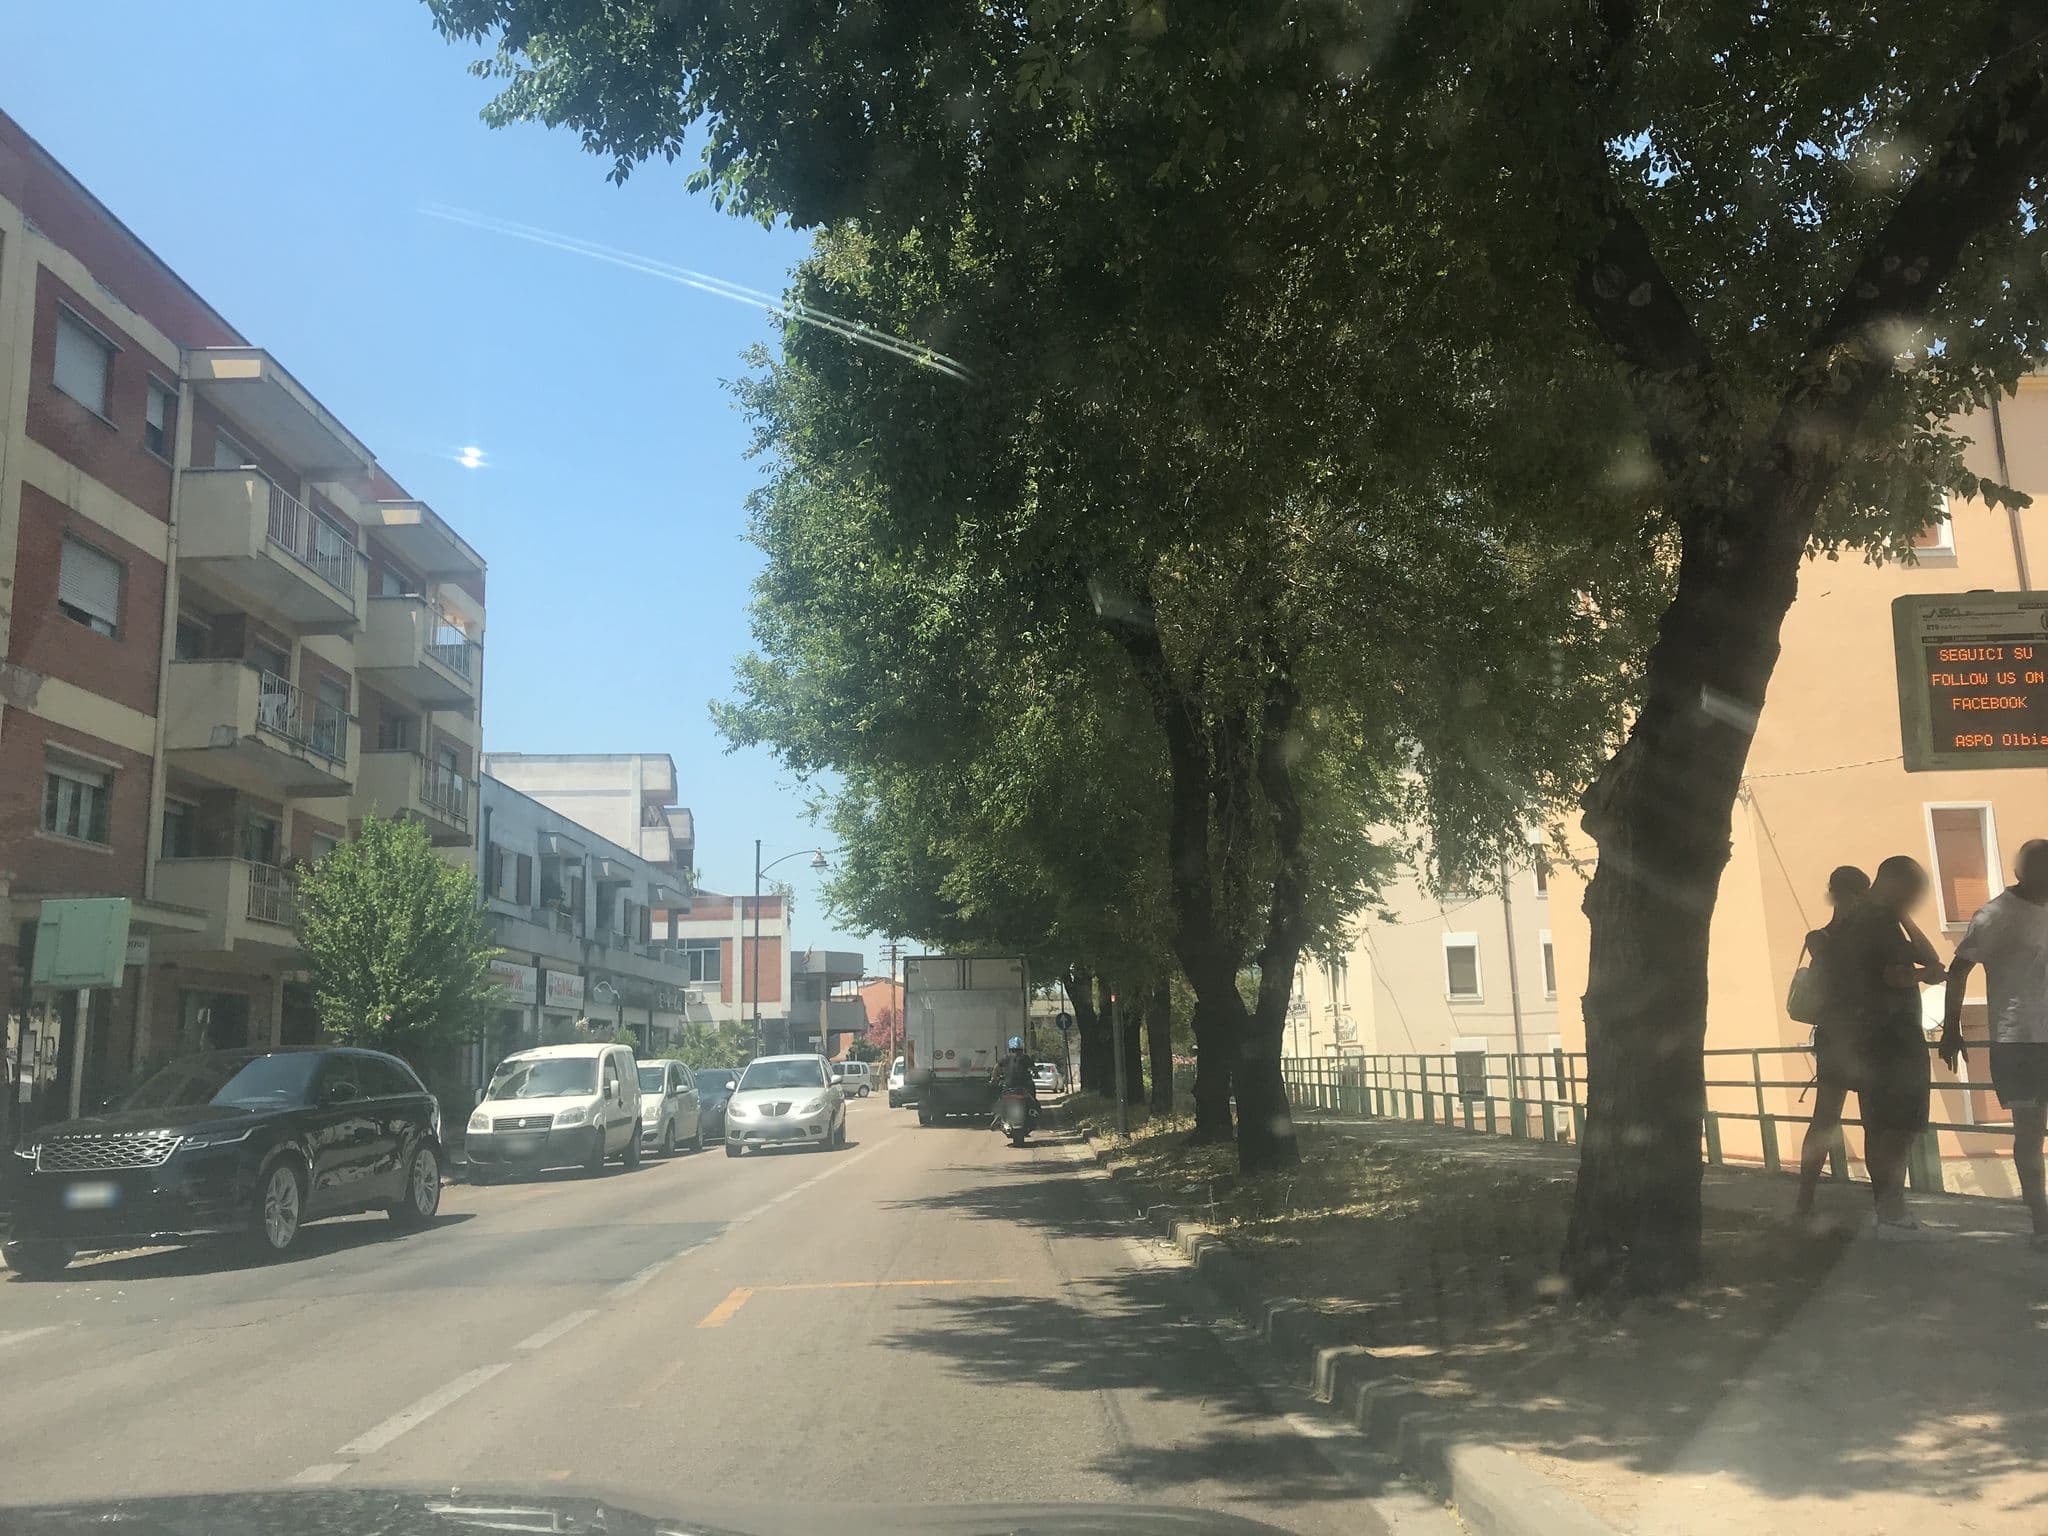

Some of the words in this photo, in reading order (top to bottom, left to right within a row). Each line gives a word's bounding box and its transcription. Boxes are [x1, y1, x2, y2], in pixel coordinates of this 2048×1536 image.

[1939, 648, 2004, 661] SEGUICI
[2014, 647, 2033, 660] SU
[1931, 673, 1988, 686] FOLLOW
[1997, 671, 2017, 685] US
[2024, 671, 2045, 684] ON
[1952, 697, 2028, 710] FACEBOOK
[1955, 734, 1994, 748] ASPO
[2001, 732, 2048, 747] Olbia
